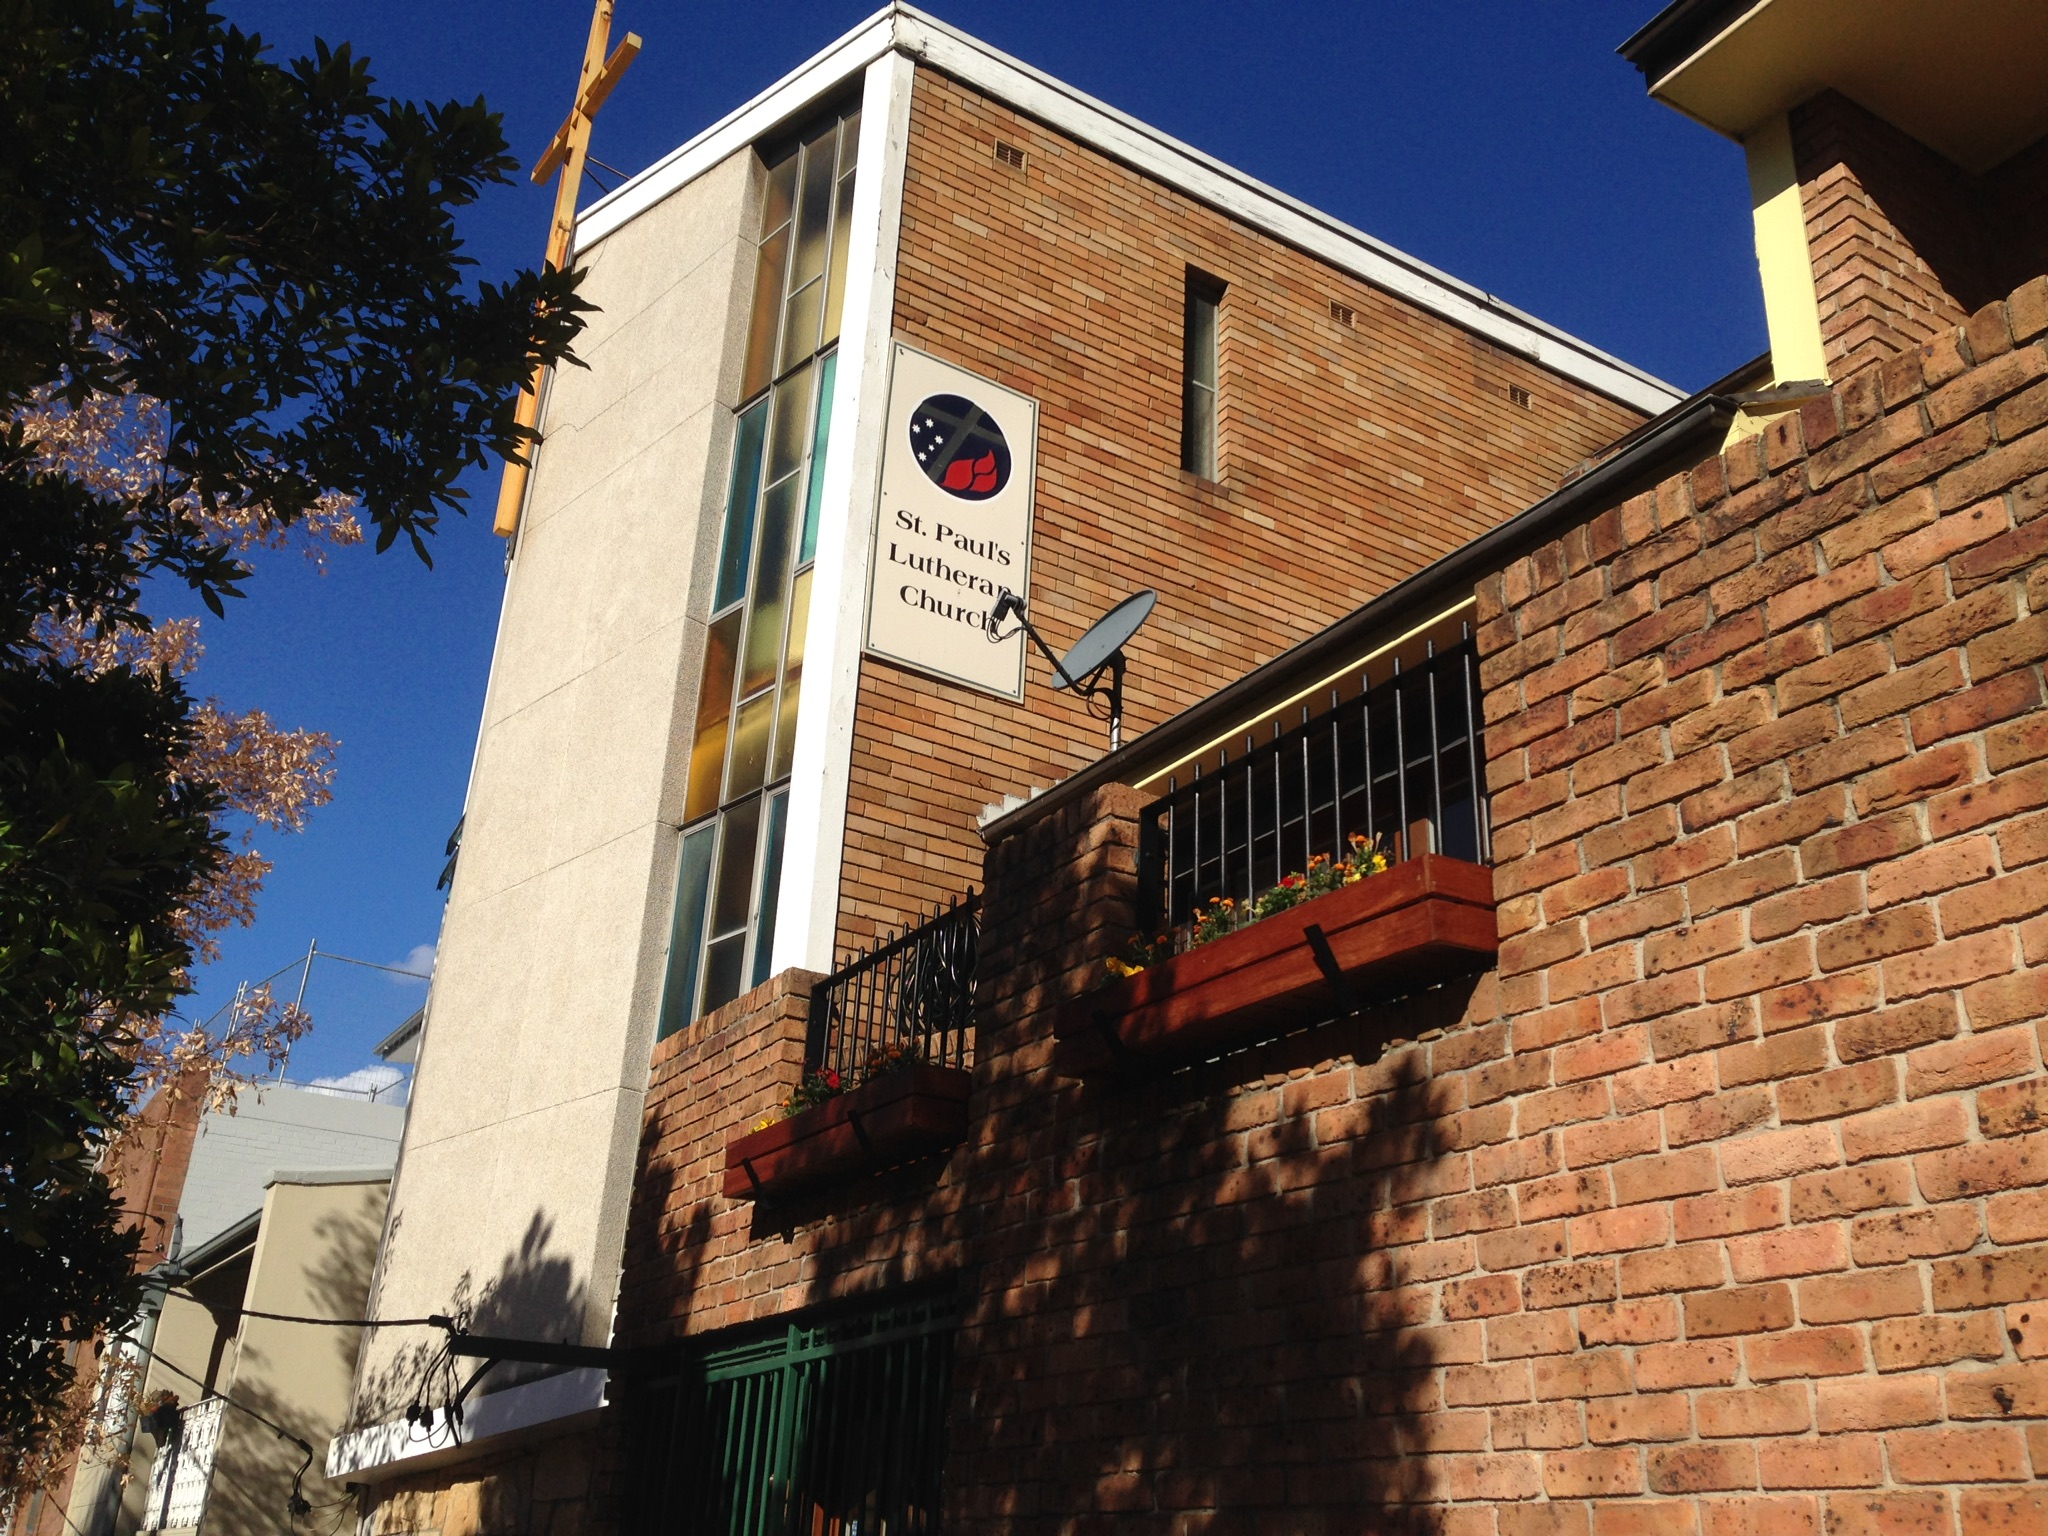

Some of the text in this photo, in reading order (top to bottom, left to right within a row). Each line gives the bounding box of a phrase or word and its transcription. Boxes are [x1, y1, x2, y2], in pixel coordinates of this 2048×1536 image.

[895, 509, 1011, 565] St. Paul's
[899, 584, 998, 634] Church
